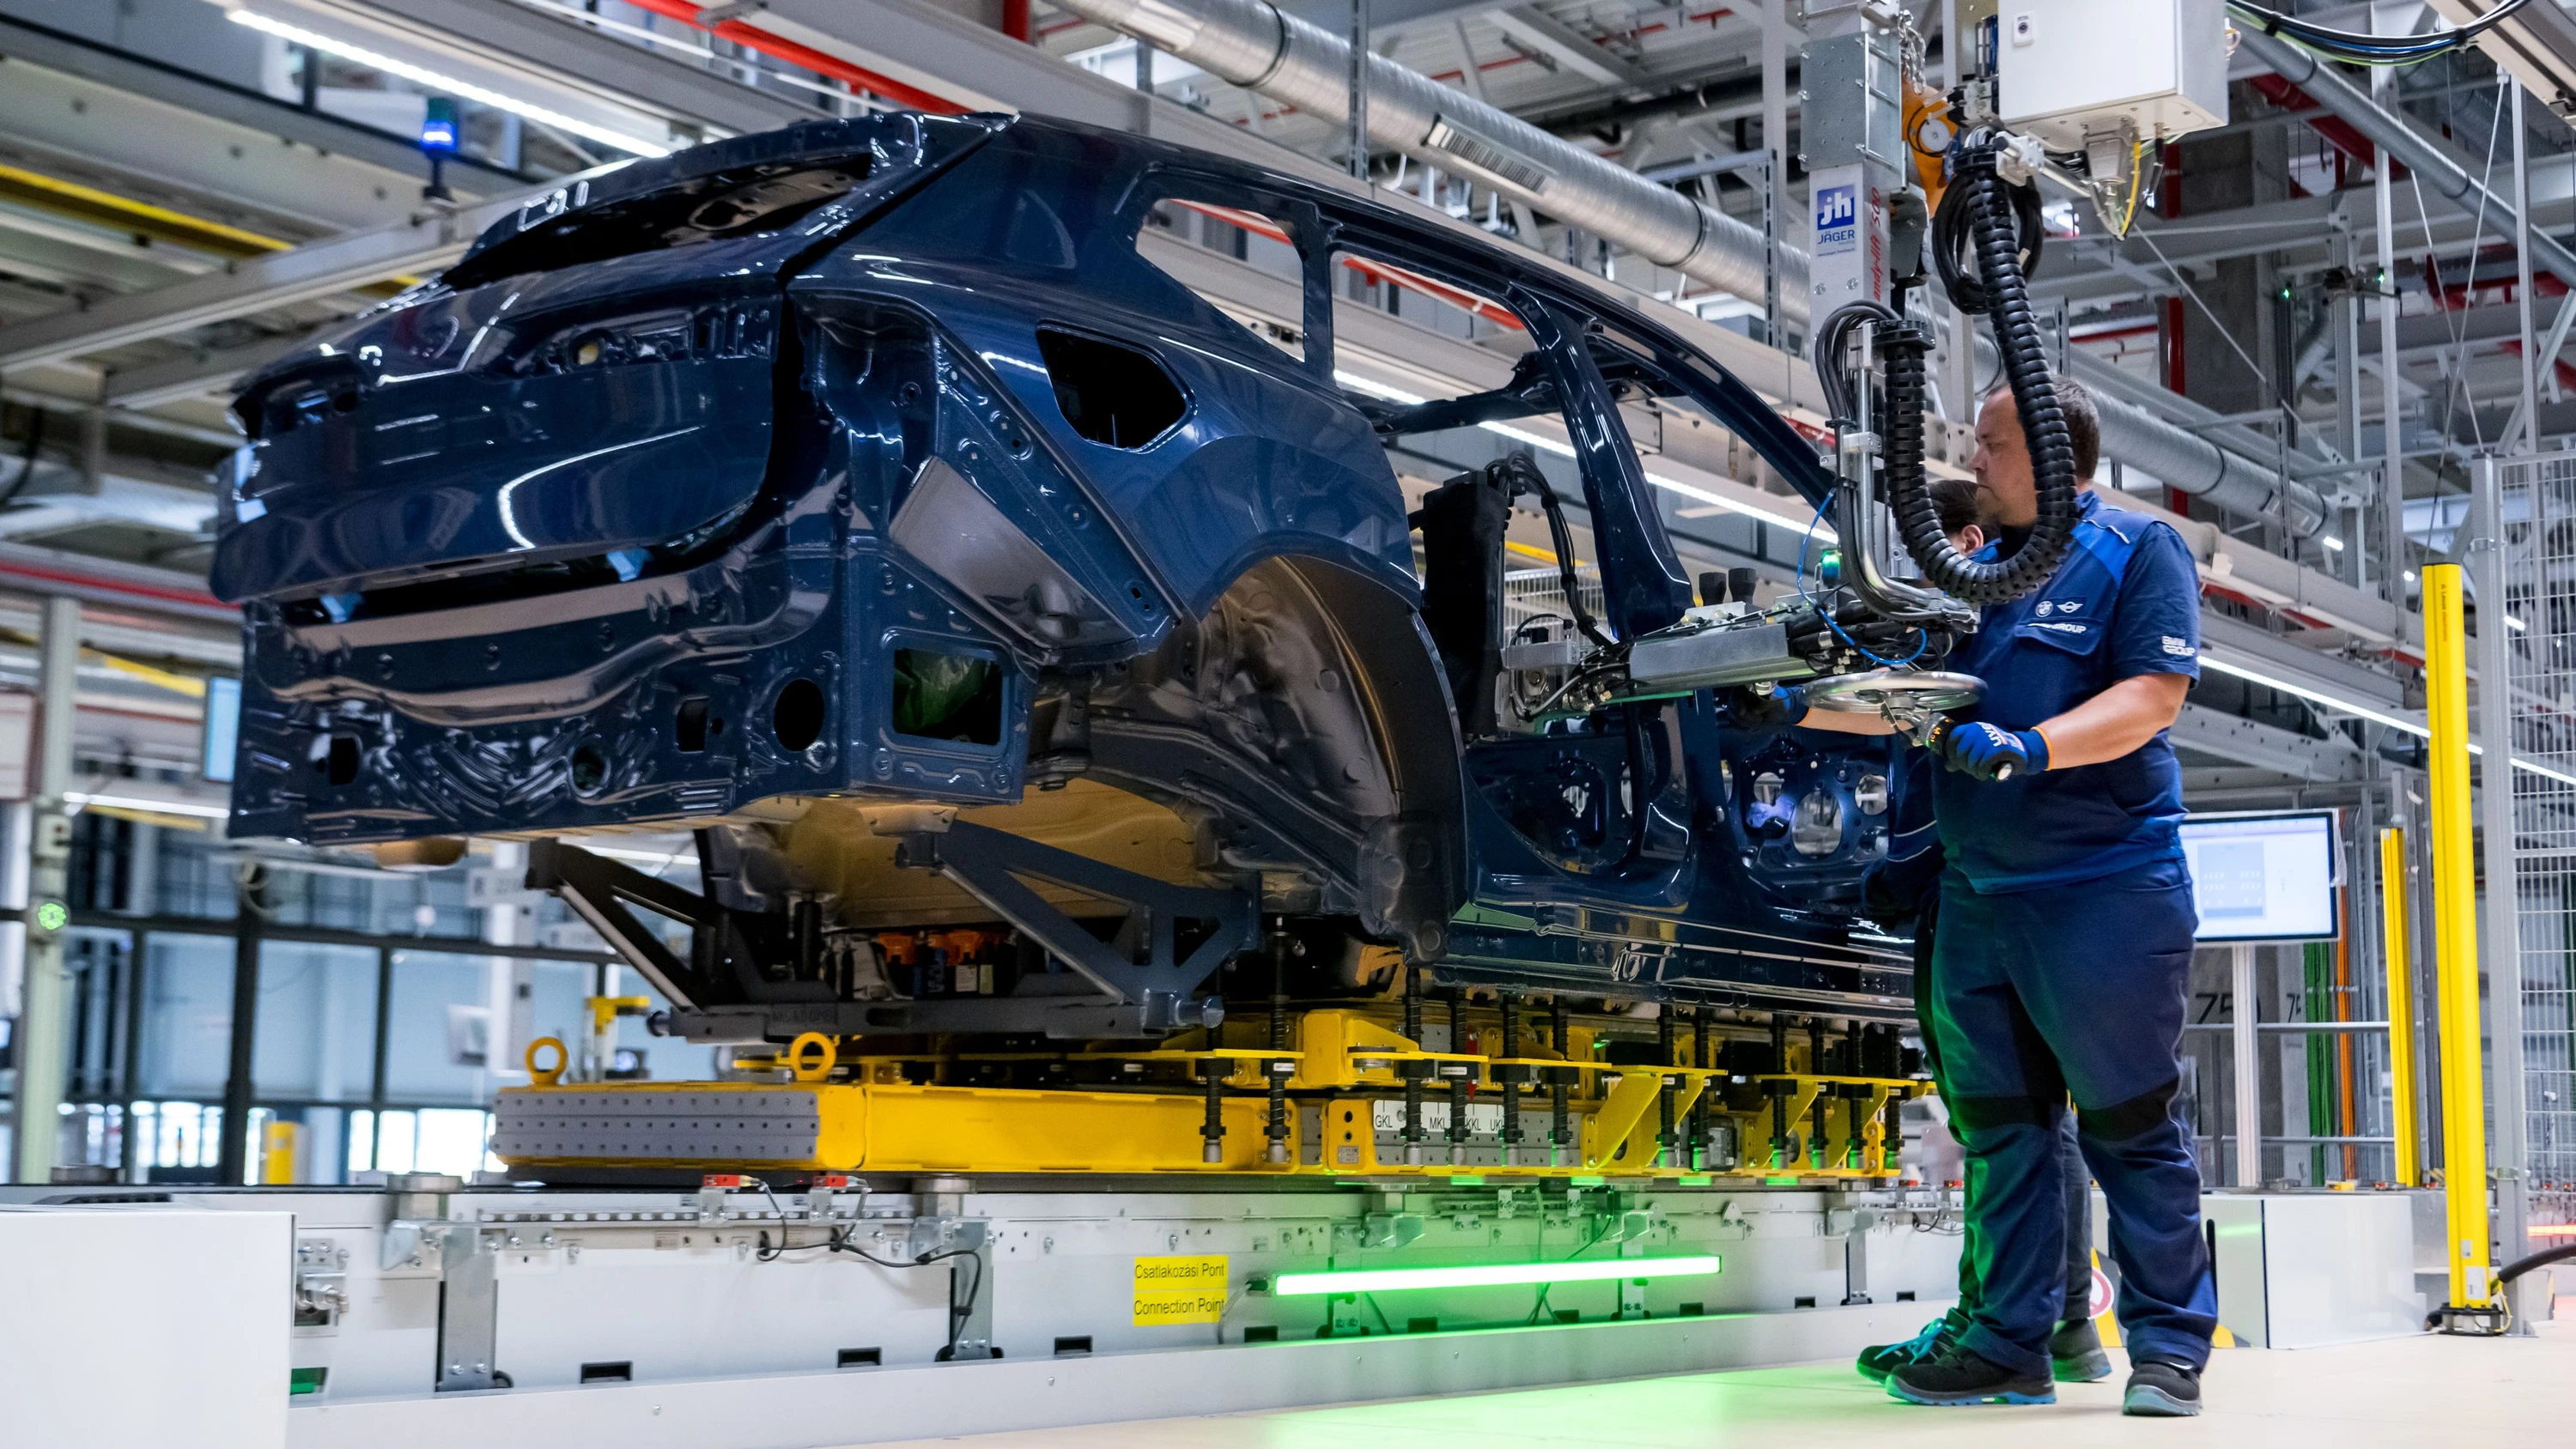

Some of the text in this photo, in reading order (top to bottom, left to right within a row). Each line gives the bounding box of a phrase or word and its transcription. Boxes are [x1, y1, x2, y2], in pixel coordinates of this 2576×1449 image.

[1820, 191, 1851, 225] jh
[1817, 229, 1855, 245] JÄGER
[1375, 1114, 1393, 1128] GKL
[1135, 1262, 1224, 1279] Csatlakozási Pont
[1134, 1297, 1225, 1315] Connection Point
